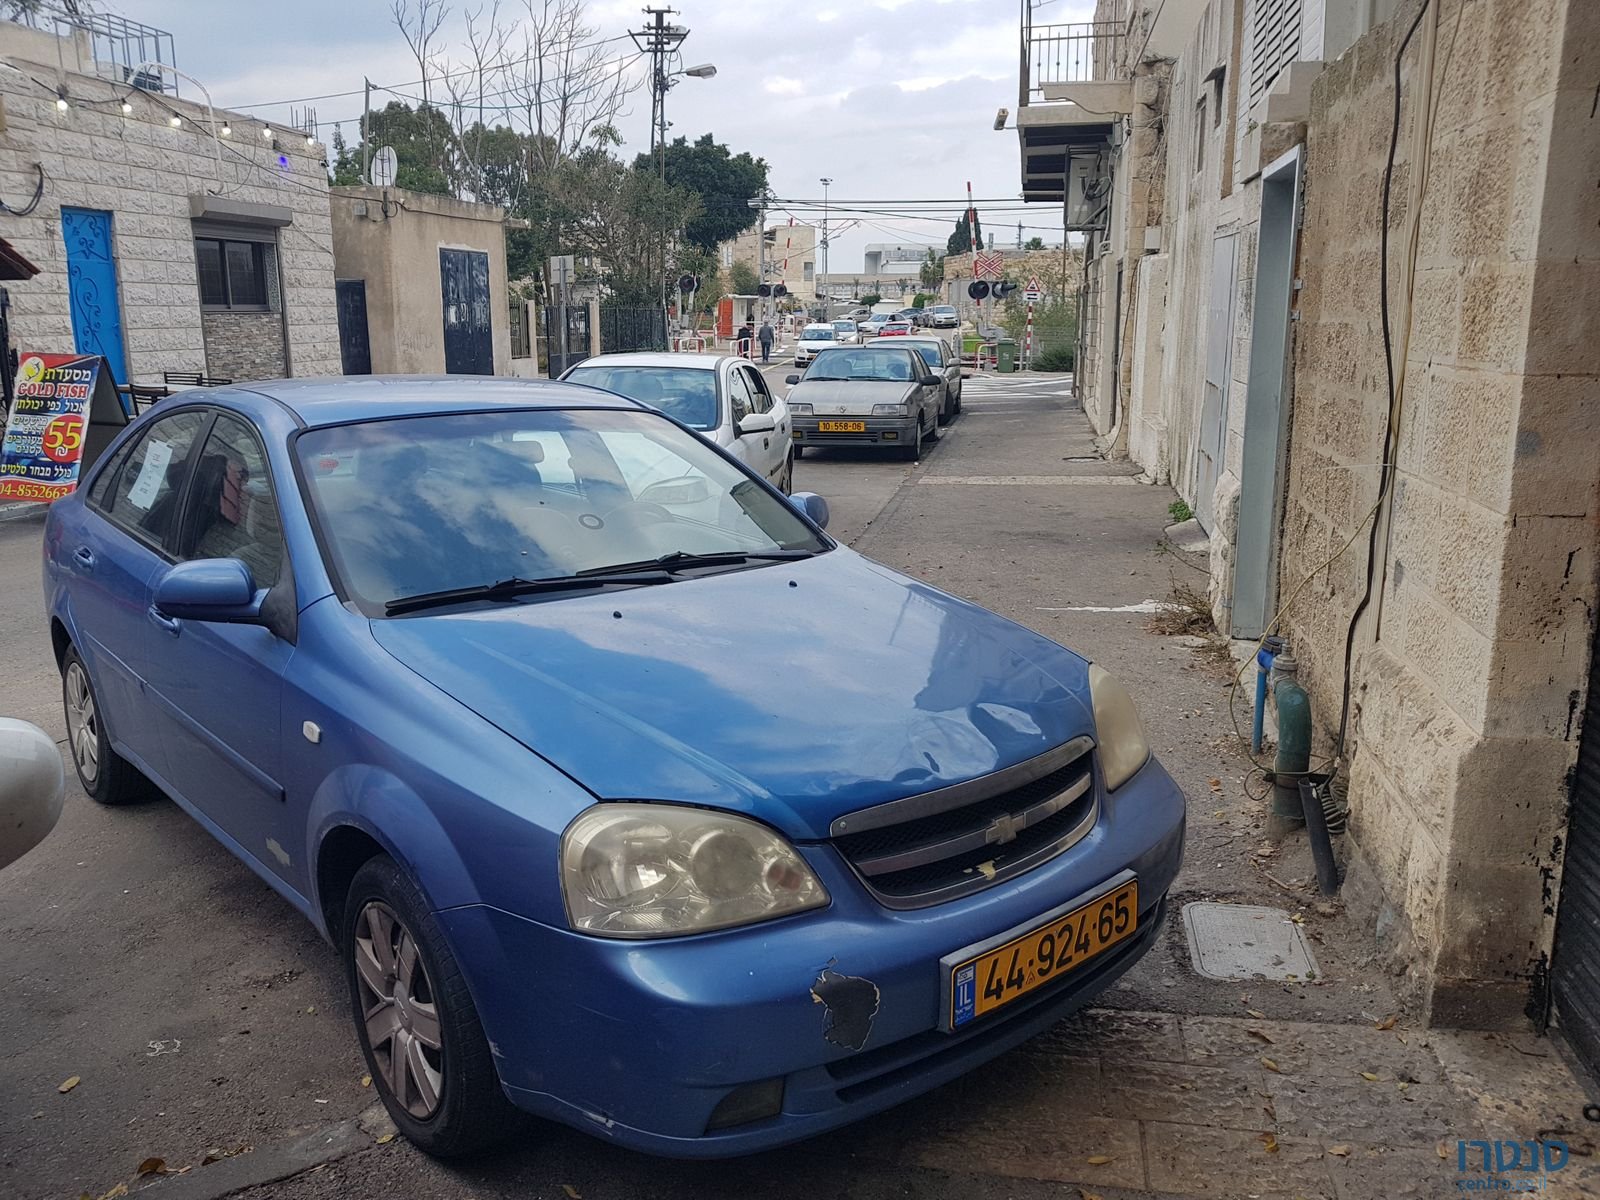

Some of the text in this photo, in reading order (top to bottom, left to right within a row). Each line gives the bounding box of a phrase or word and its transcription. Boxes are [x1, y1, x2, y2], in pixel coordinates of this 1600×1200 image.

[17, 382, 89, 399] GOLD FISH
[47, 400, 61, 411] כפי
[45, 421, 83, 450] 55
[1, 463, 72, 477] כולל מבחר סלטים
[960, 984, 971, 1007] IL
